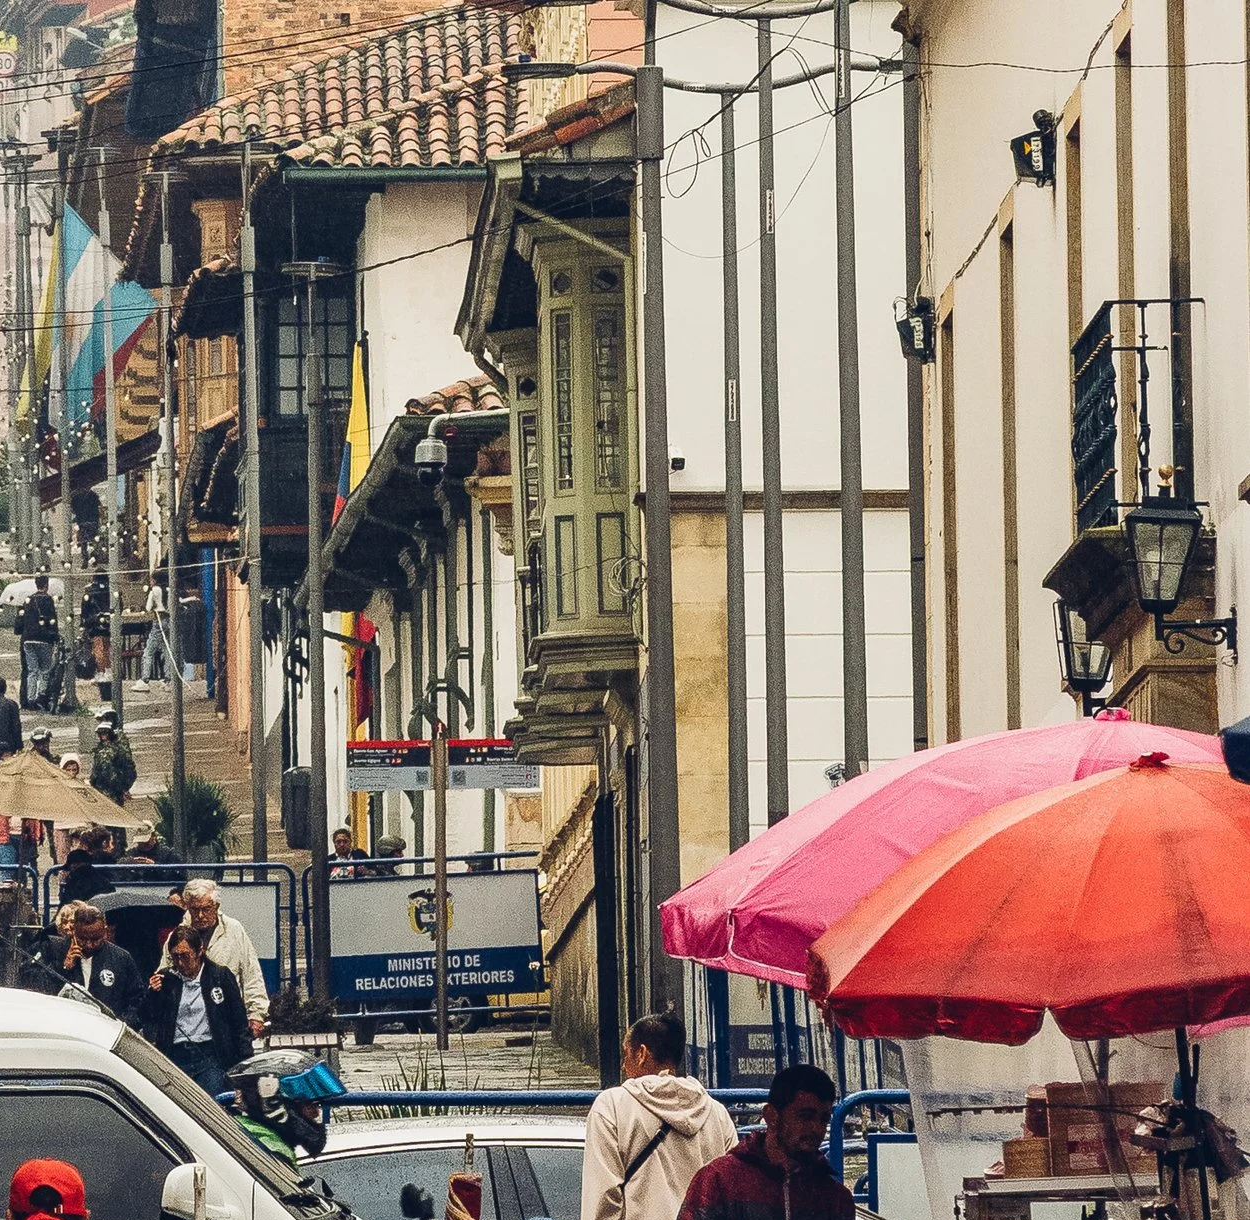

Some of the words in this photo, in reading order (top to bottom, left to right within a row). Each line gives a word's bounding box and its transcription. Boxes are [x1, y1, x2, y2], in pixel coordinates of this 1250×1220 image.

[388, 955, 460, 972] MINISTEIO
[464, 954, 481, 968] DE
[355, 974, 434, 991] RELACIONES
[445, 970, 515, 986] XTERIORES
